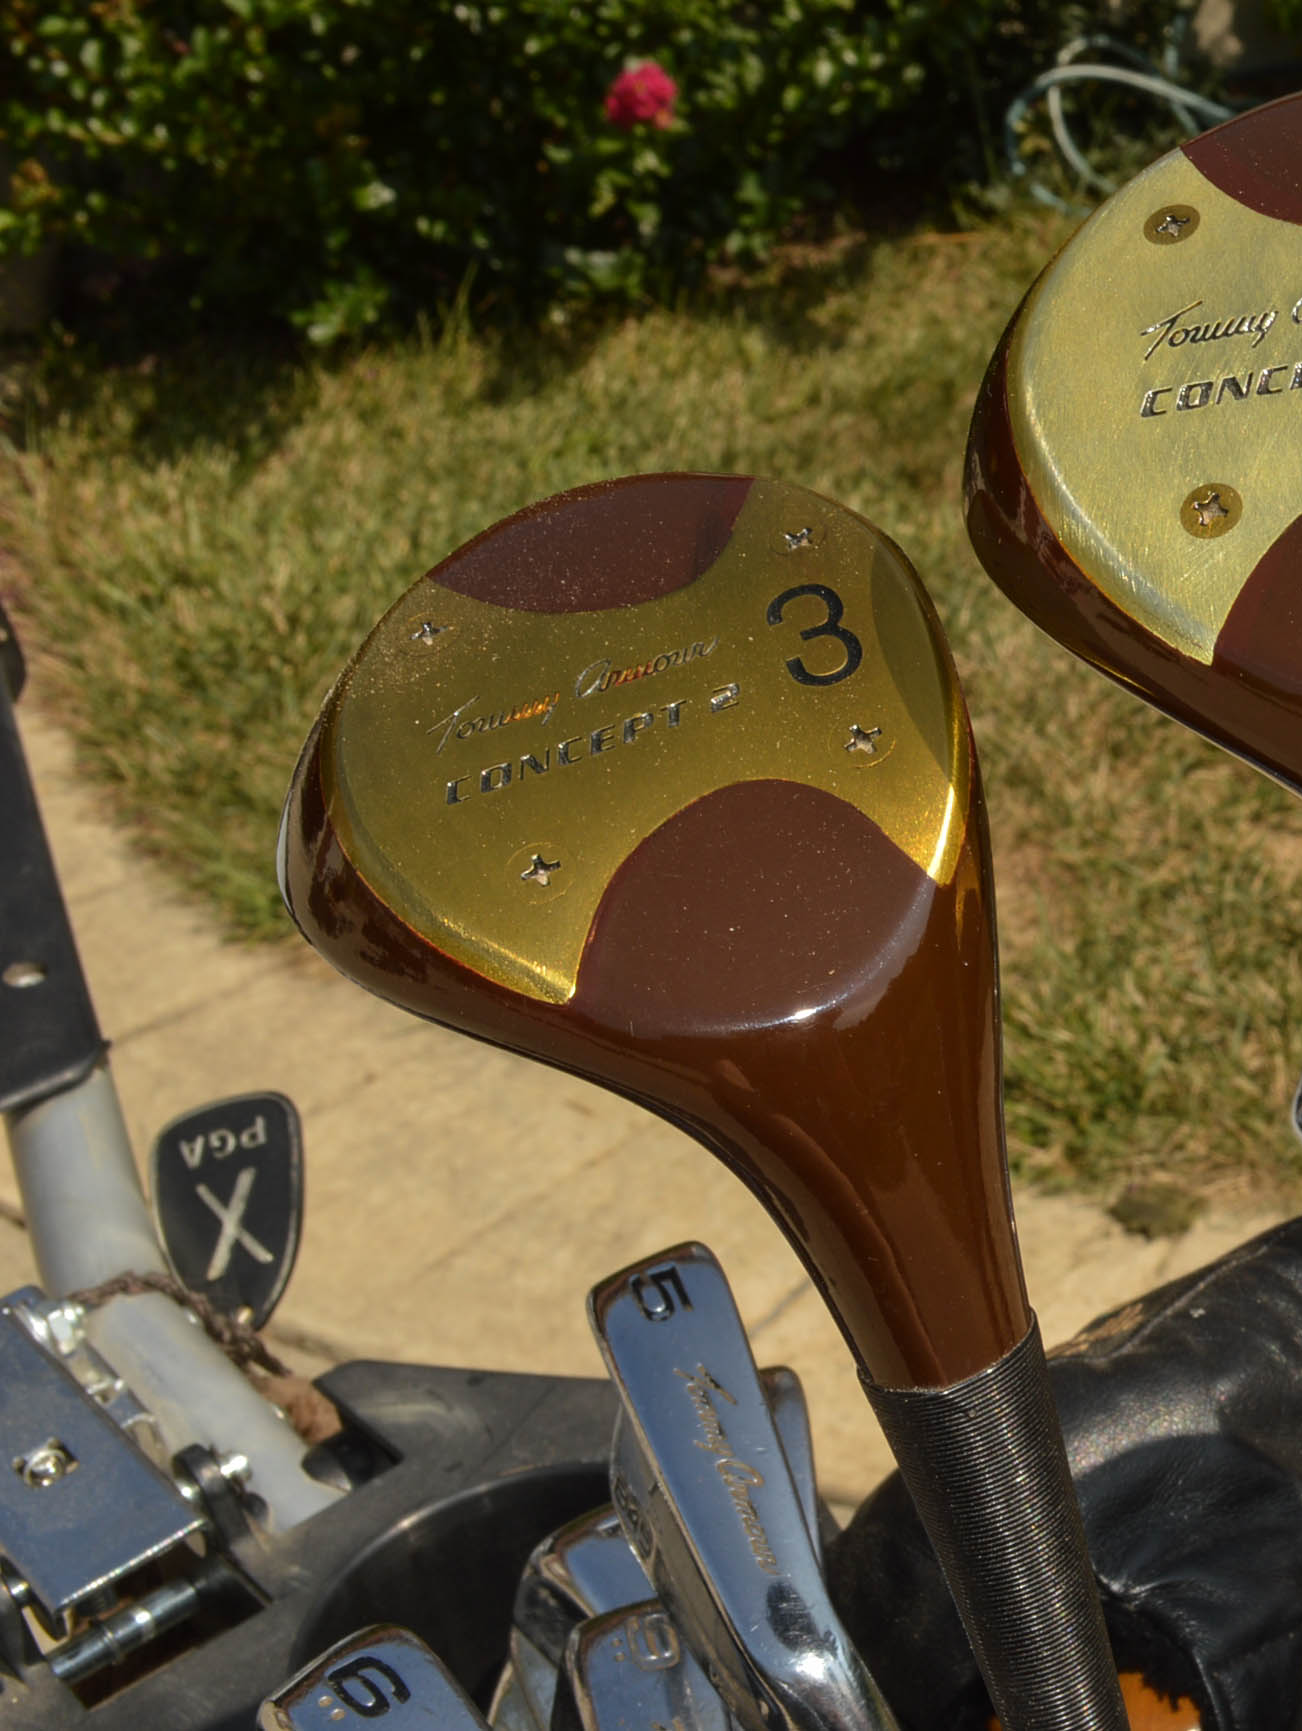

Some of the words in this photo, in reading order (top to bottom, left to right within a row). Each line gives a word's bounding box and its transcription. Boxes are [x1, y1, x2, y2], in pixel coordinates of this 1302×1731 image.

[1141, 300, 1278, 360] Tommy
[766, 583, 863, 686] 3
[426, 693, 560, 754] Tommy
[574, 636, 719, 699] Armour
[446, 700, 687, 805] CONCEPT
[710, 682, 741, 713] 2
[178, 1115, 268, 1169] PGA
[196, 1167, 275, 1282] X
[630, 1266, 695, 1323] 5
[327, 1655, 412, 1719] 6
